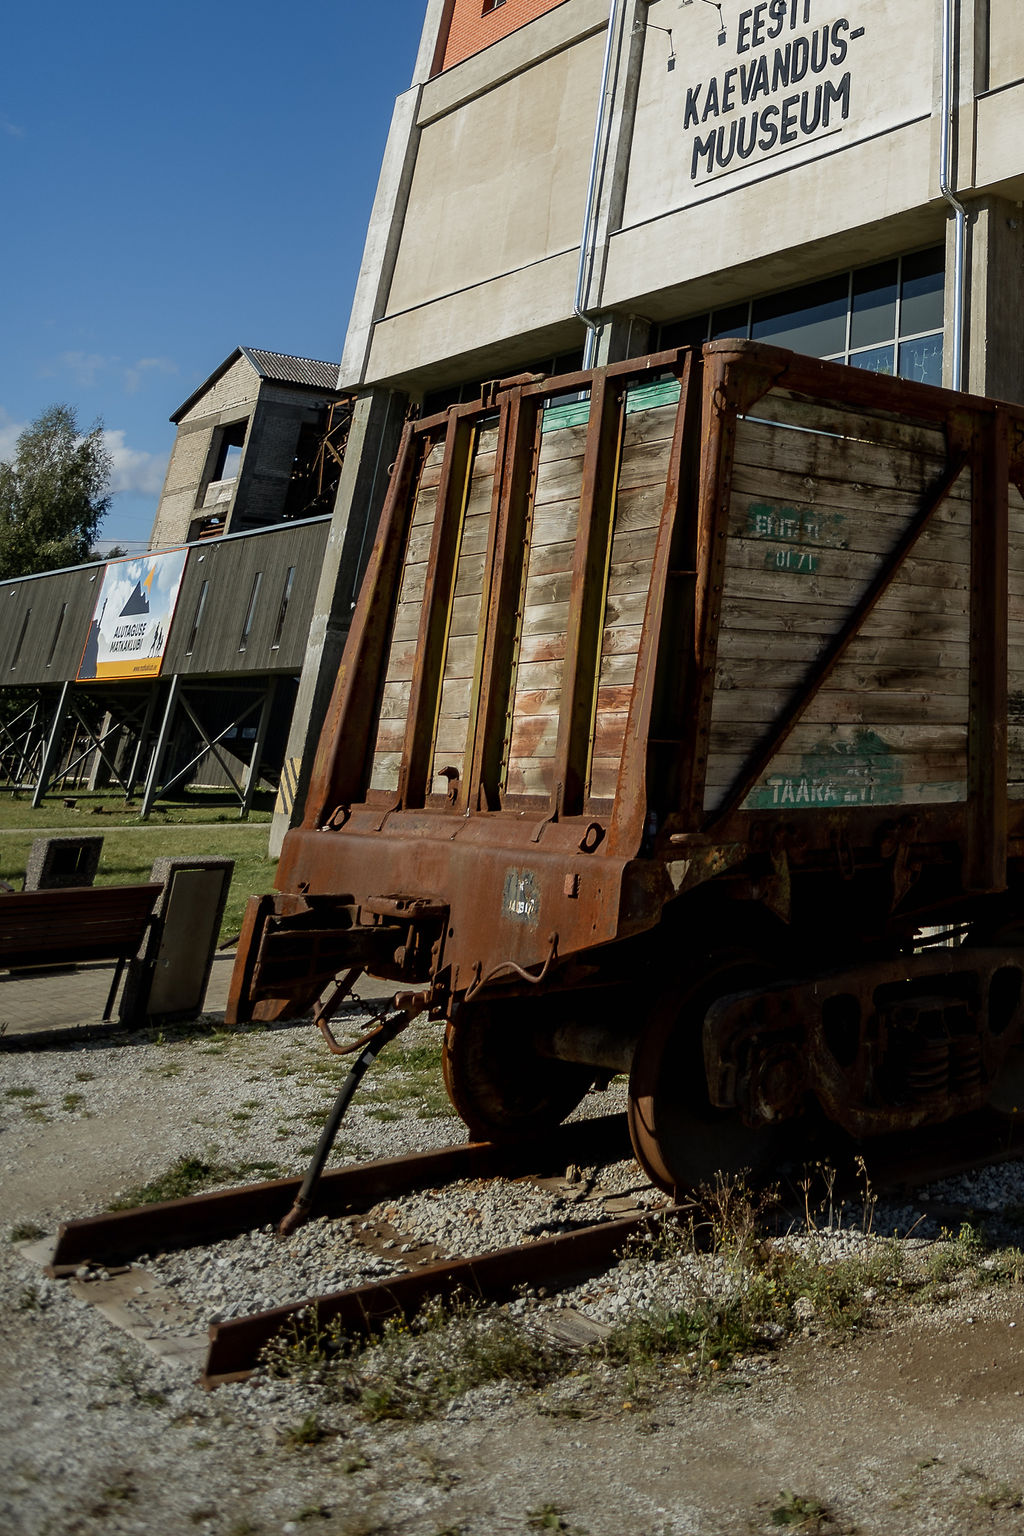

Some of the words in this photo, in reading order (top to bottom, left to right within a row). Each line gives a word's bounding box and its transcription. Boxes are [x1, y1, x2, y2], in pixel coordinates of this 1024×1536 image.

[683, 18, 865, 130] KAEVANDUS-
[691, 71, 851, 179] MUUSEUM
[113, 622, 147, 639] ALUTAGUSE
[109, 638, 144, 653] MATKAKLUBI
[767, 778, 837, 804] TAARA
